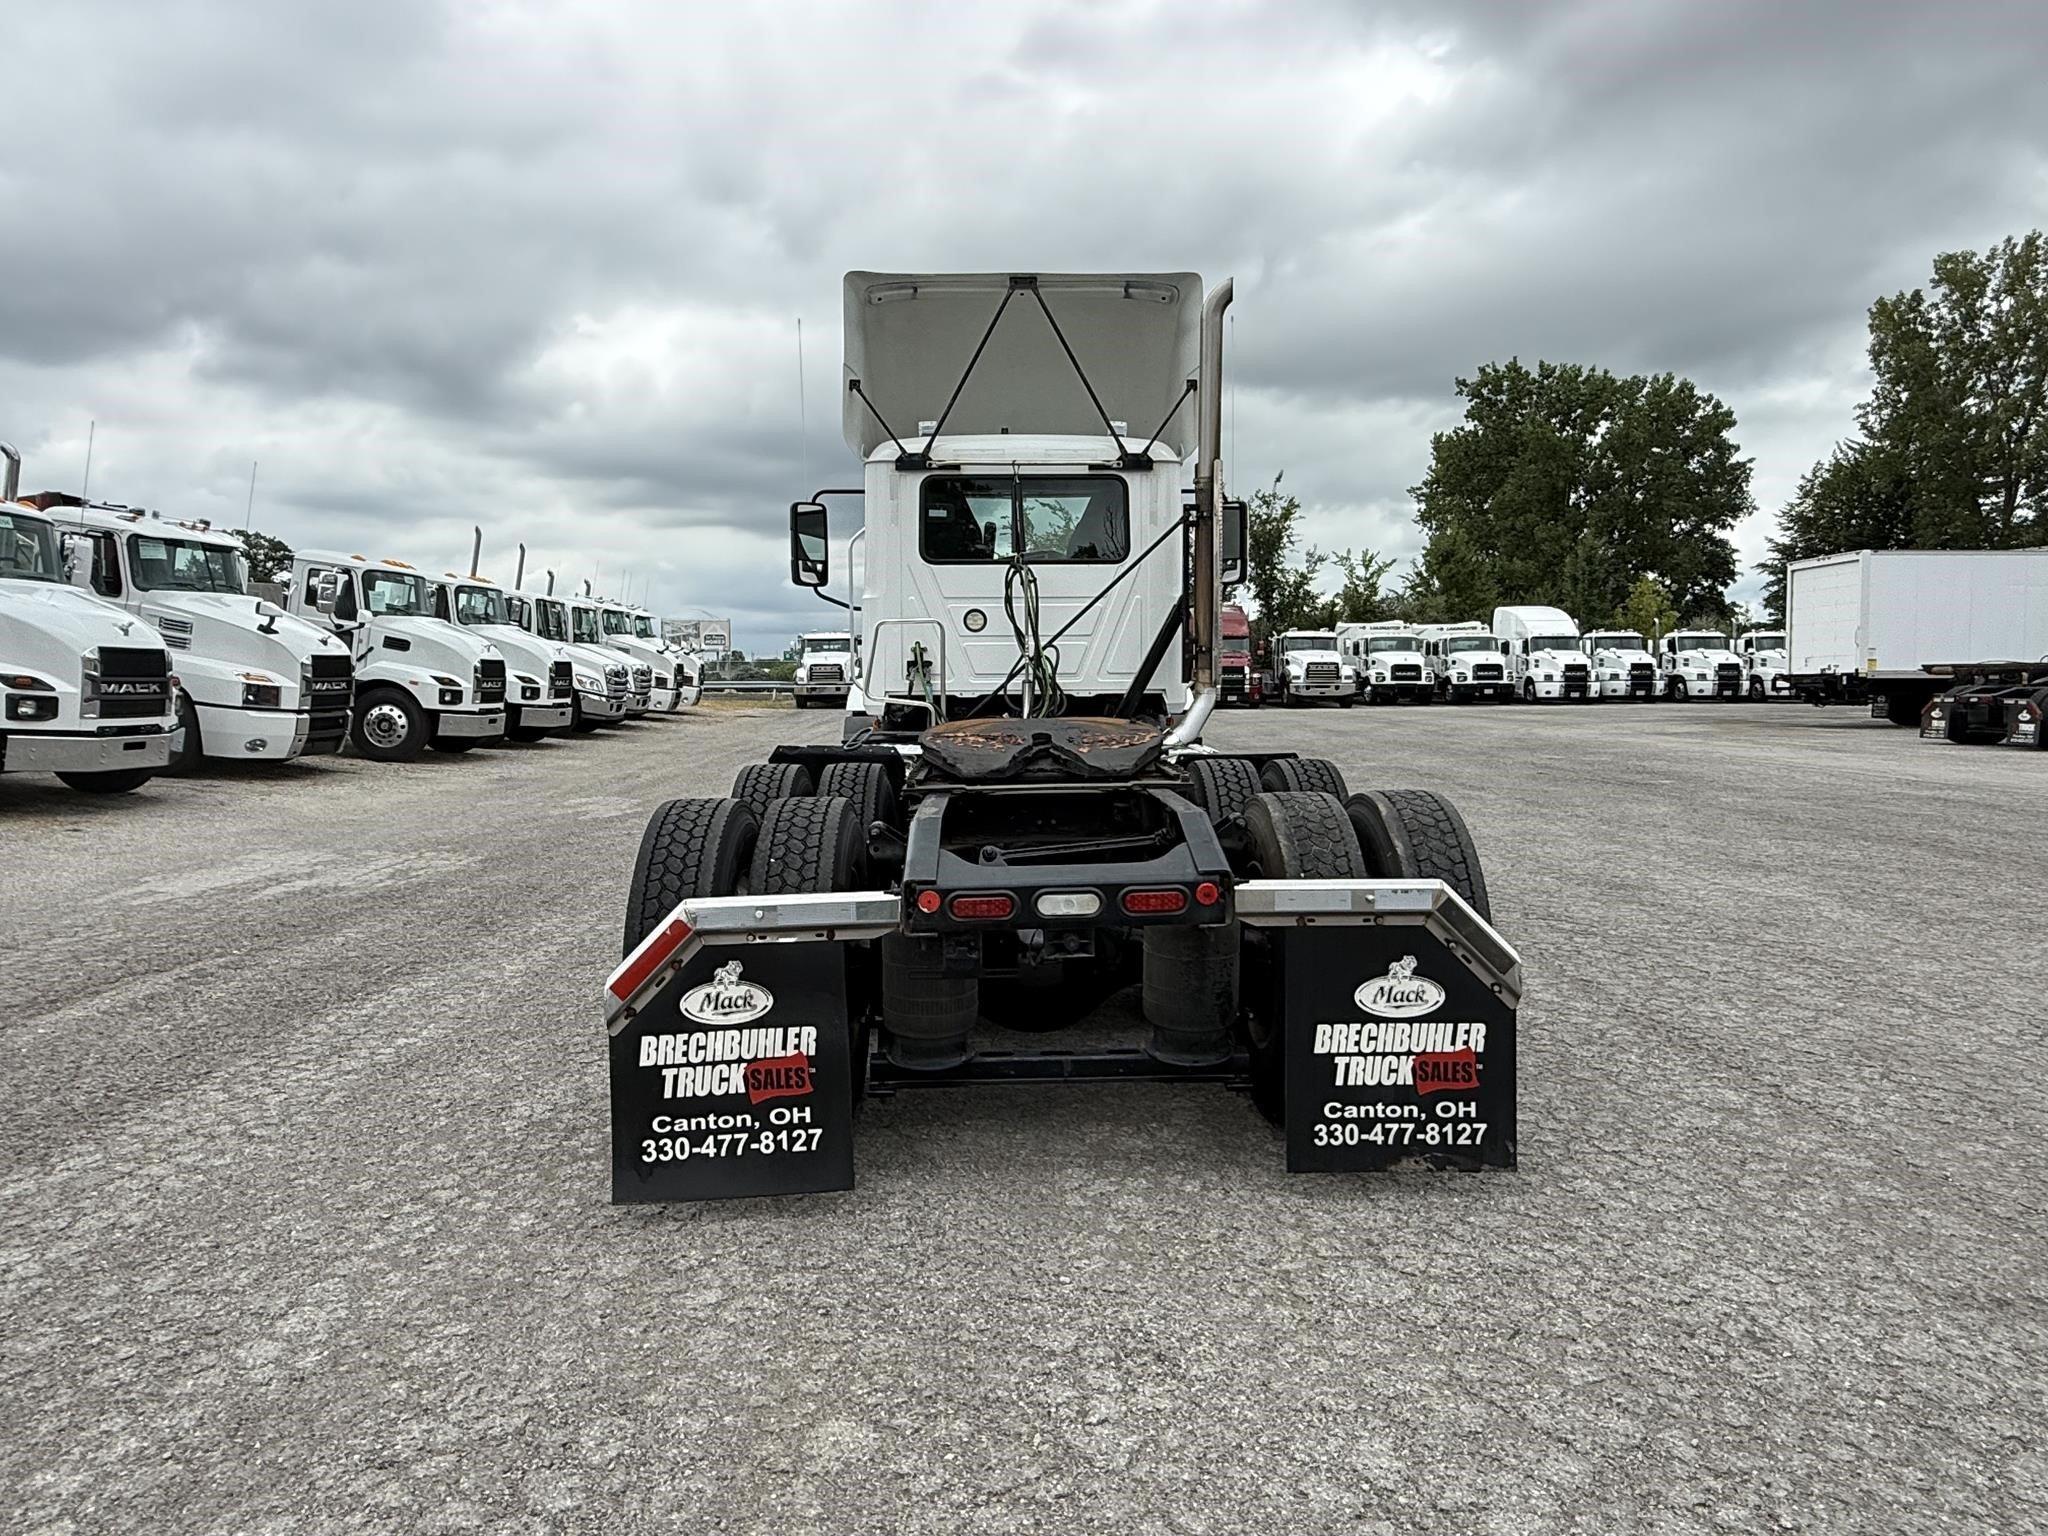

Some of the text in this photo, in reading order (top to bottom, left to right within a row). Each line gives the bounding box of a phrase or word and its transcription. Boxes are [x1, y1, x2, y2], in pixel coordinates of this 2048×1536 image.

[100, 683, 161, 694] MACK
[311, 682, 348, 690] MACK
[697, 989, 758, 1013] Mack
[1372, 984, 1427, 1004] Mack
[639, 1026, 817, 1067] BRECHBUHLER
[1313, 1023, 1487, 1054] BRECHBUHLER
[661, 1063, 806, 1099] TRUCK SALES
[1334, 1055, 1474, 1086] TRUCK SALES
[652, 1106, 812, 1134] Canton, OH
[1323, 1101, 1477, 1121] Canton, OH
[641, 1128, 823, 1163] 330-477-8127
[1313, 1123, 1488, 1147] 330-477-8127
